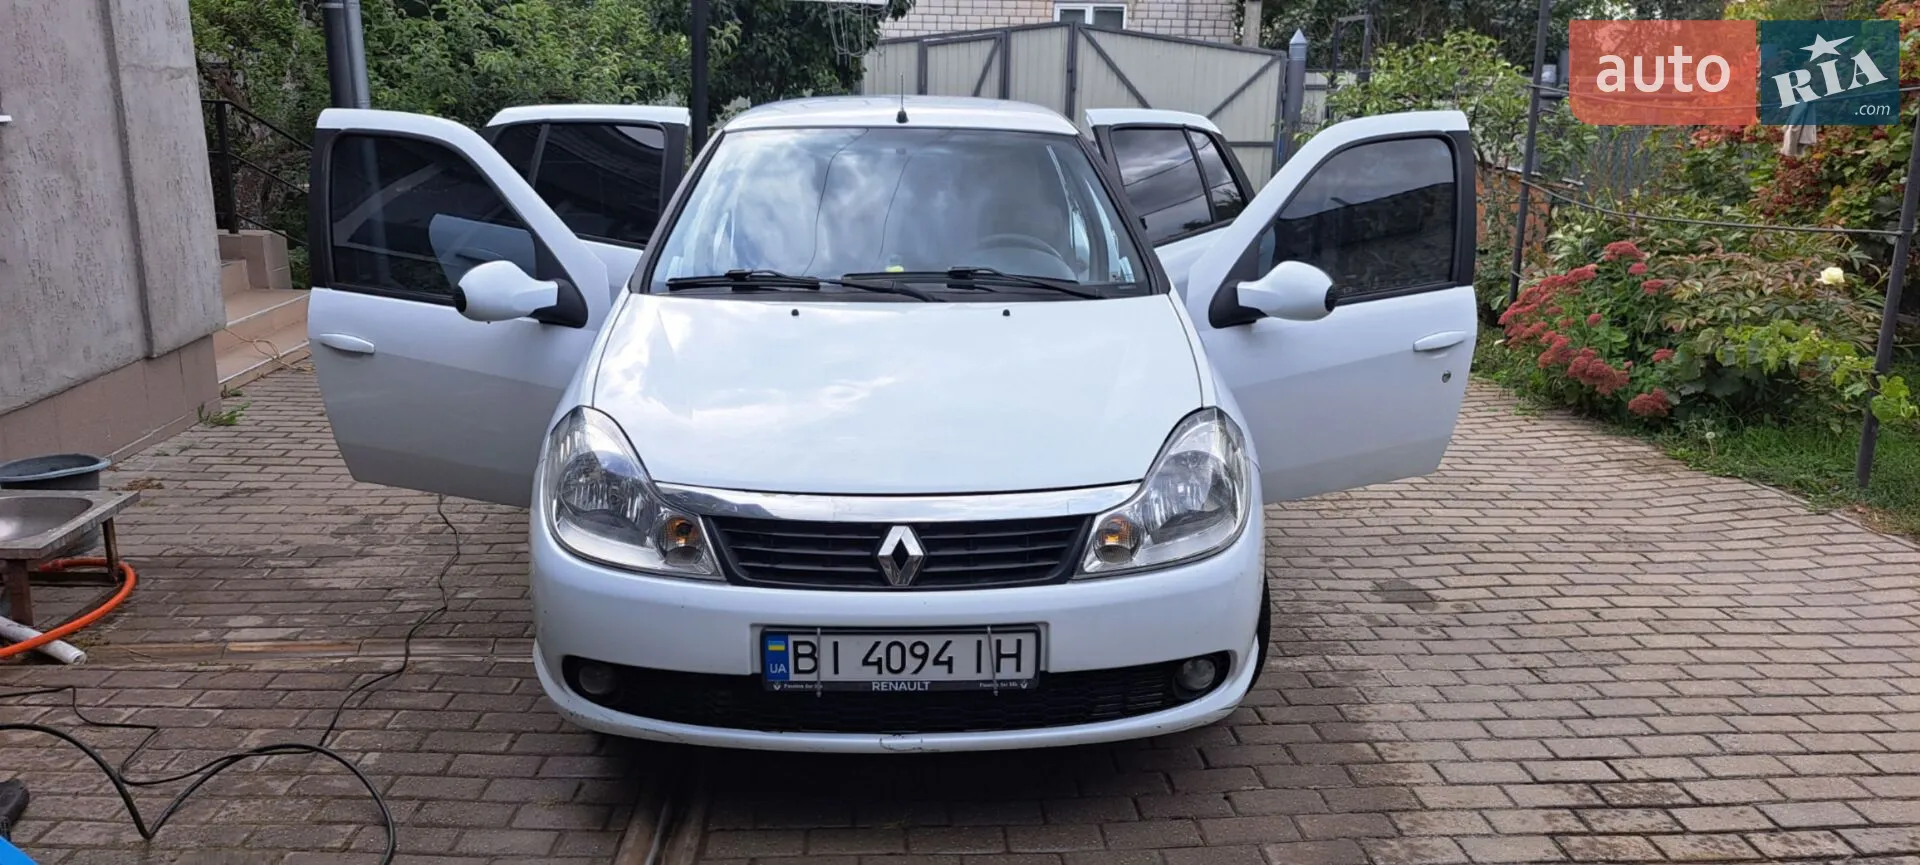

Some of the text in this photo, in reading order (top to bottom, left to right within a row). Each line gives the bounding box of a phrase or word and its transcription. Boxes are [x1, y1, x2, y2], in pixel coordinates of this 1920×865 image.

[861, 639, 954, 675] 4094
[769, 663, 787, 674] UA
[871, 681, 931, 691] RENAULT
